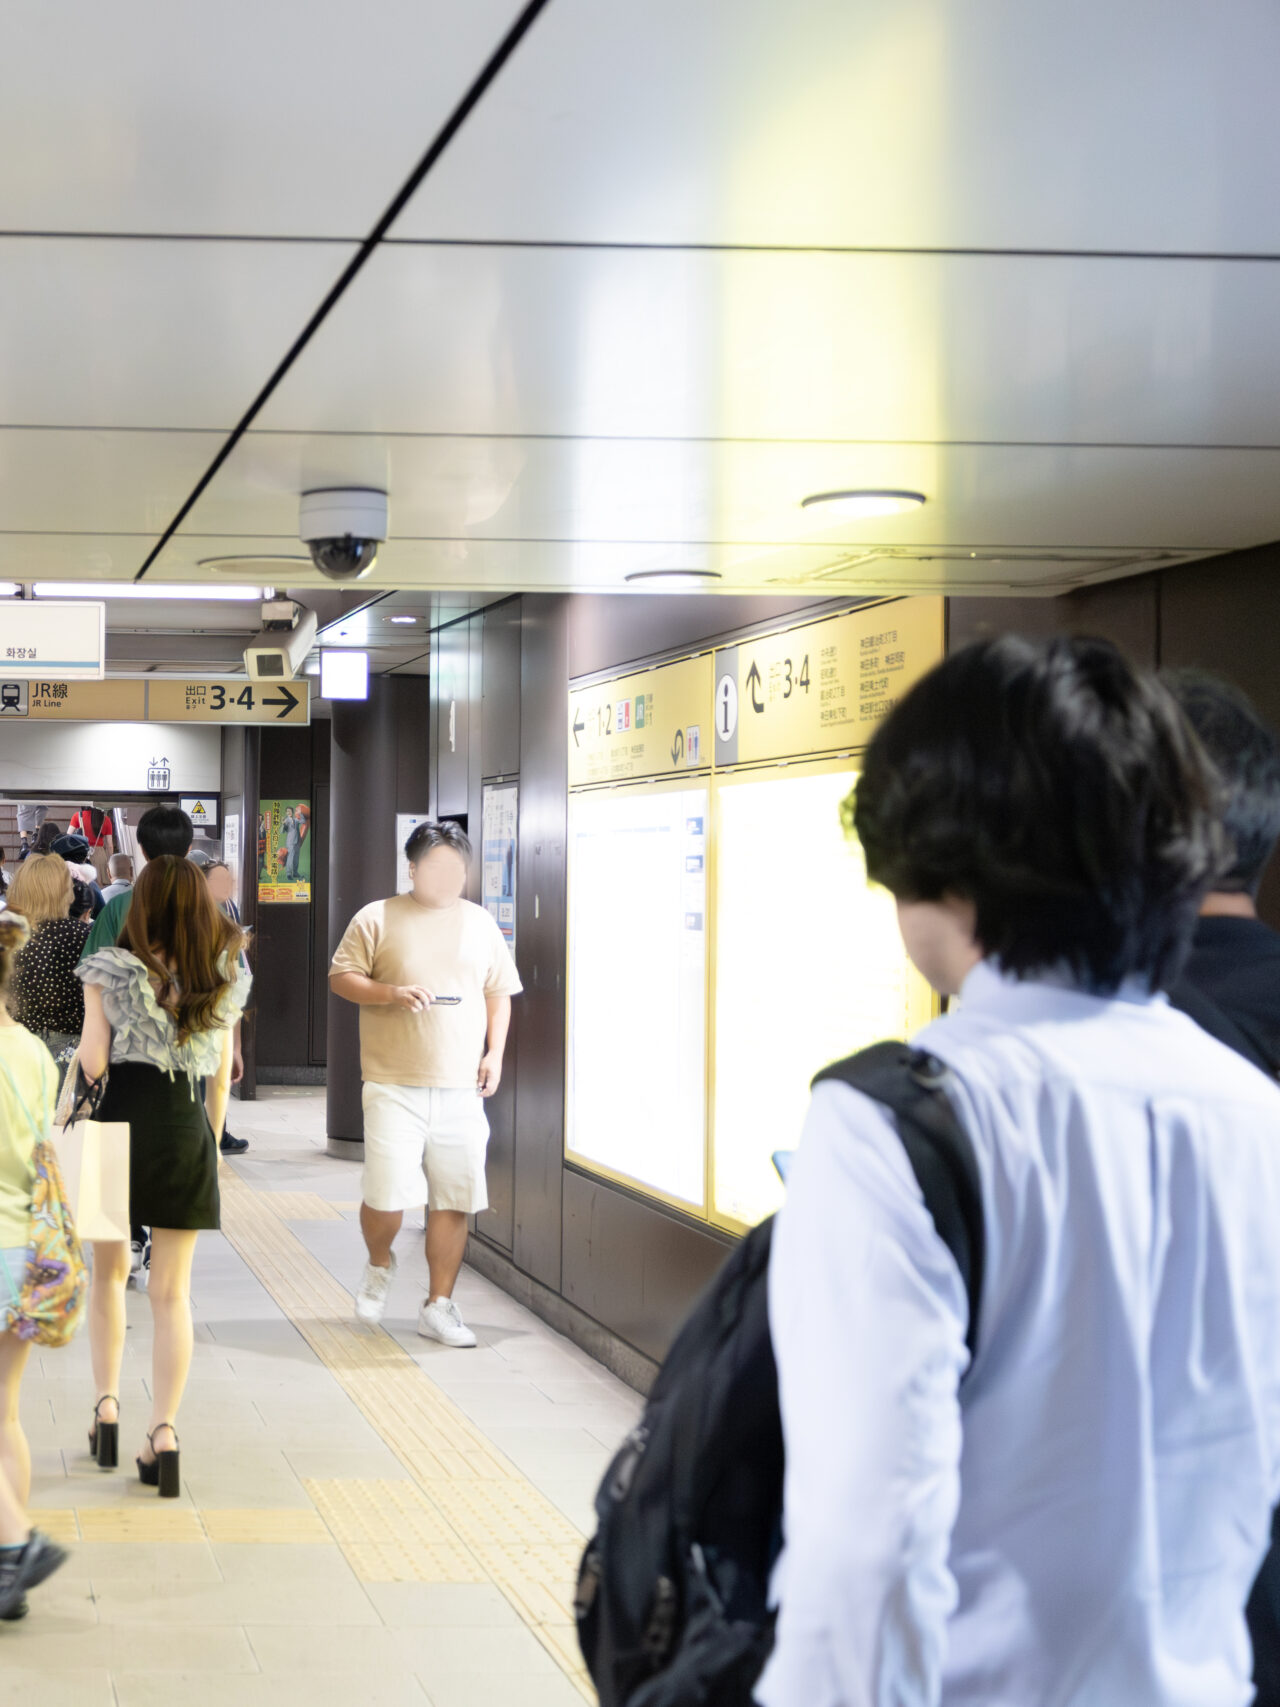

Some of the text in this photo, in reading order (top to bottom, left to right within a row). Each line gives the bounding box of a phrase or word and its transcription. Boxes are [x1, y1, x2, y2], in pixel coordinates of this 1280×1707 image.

[6, 647, 37, 659] 화장실
[32, 683, 68, 699] JR線
[186, 685, 206, 696] 出口
[44, 700, 62, 708] Line
[186, 696, 206, 705] Exit
